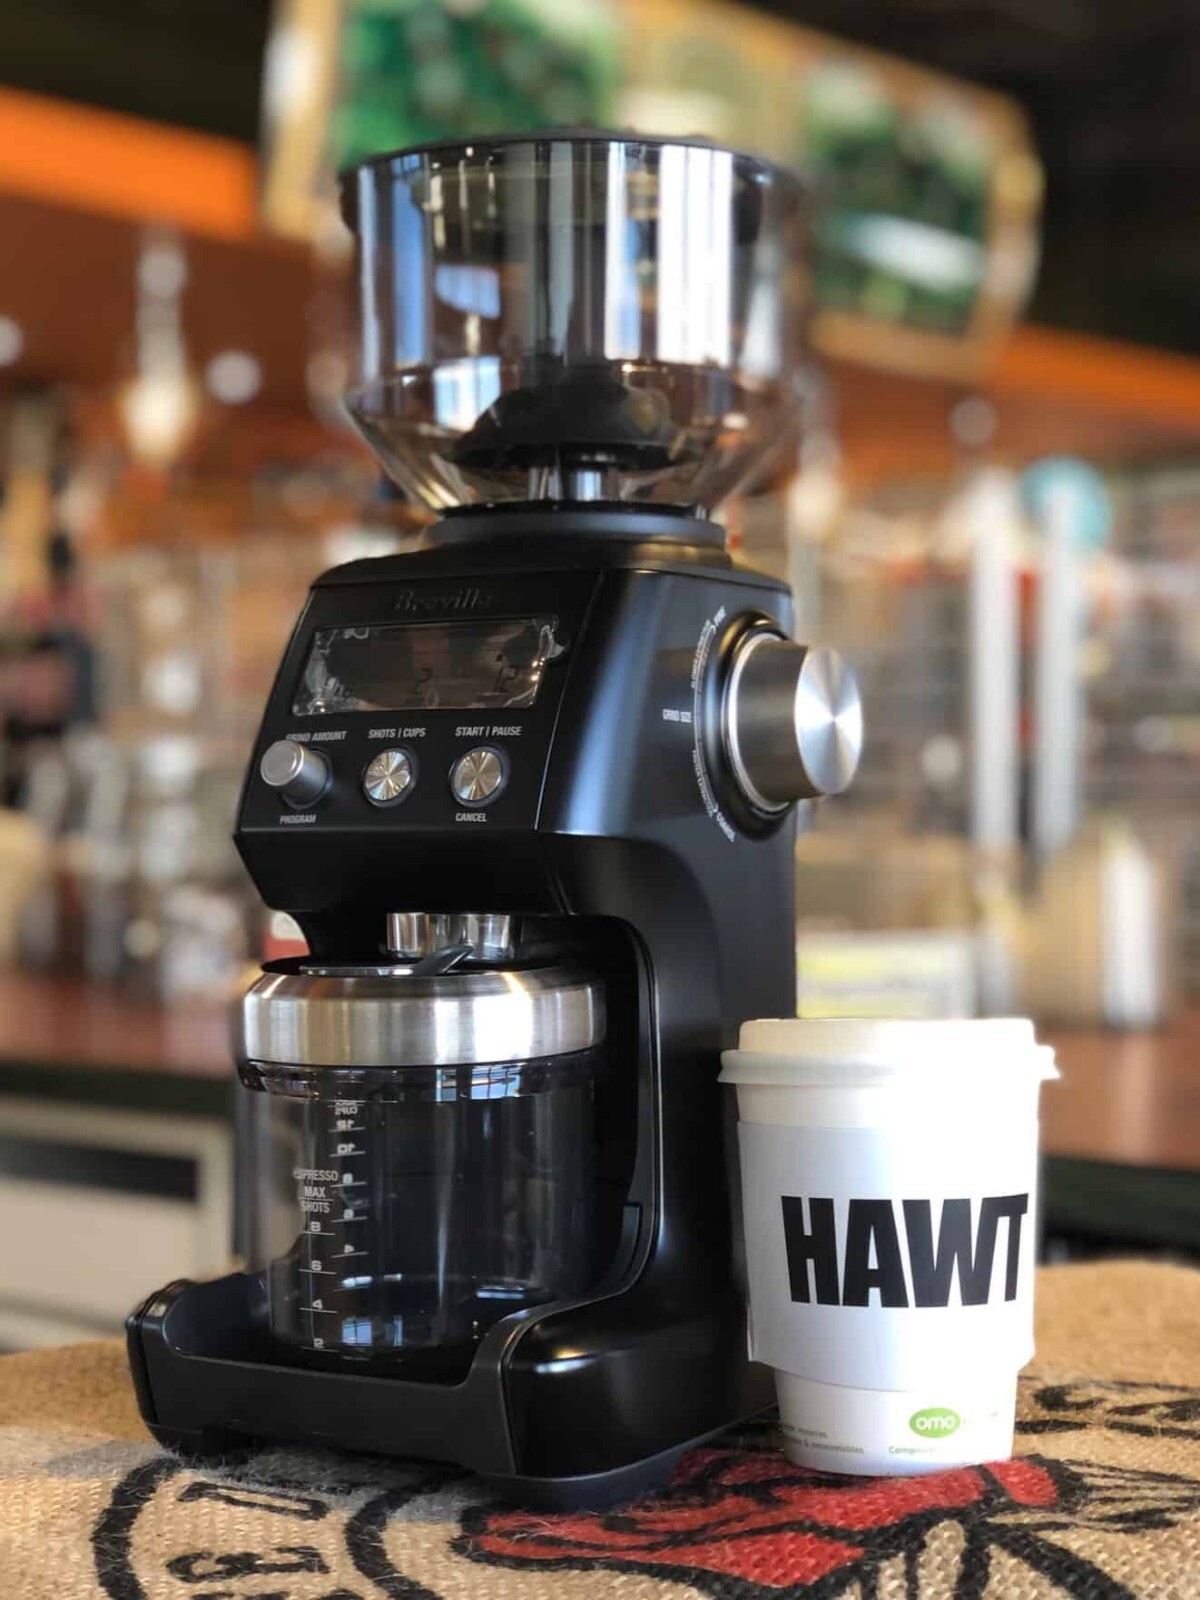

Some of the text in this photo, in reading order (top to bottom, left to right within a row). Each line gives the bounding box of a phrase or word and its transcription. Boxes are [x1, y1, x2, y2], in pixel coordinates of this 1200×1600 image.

[311, 730, 348, 741] AMOUNT
[368, 729, 397, 739] SHOTS
[402, 727, 426, 738] CUPS
[455, 726, 485, 737] START
[491, 725, 523, 737] PAUSE
[279, 814, 317, 824] PROGRAM
[455, 812, 487, 822] CANCEL
[304, 1185, 326, 1198] MAX
[781, 1192, 1029, 1308] HAWT
[312, 1299, 323, 1310] 4
[916, 1415, 955, 1432] omo
